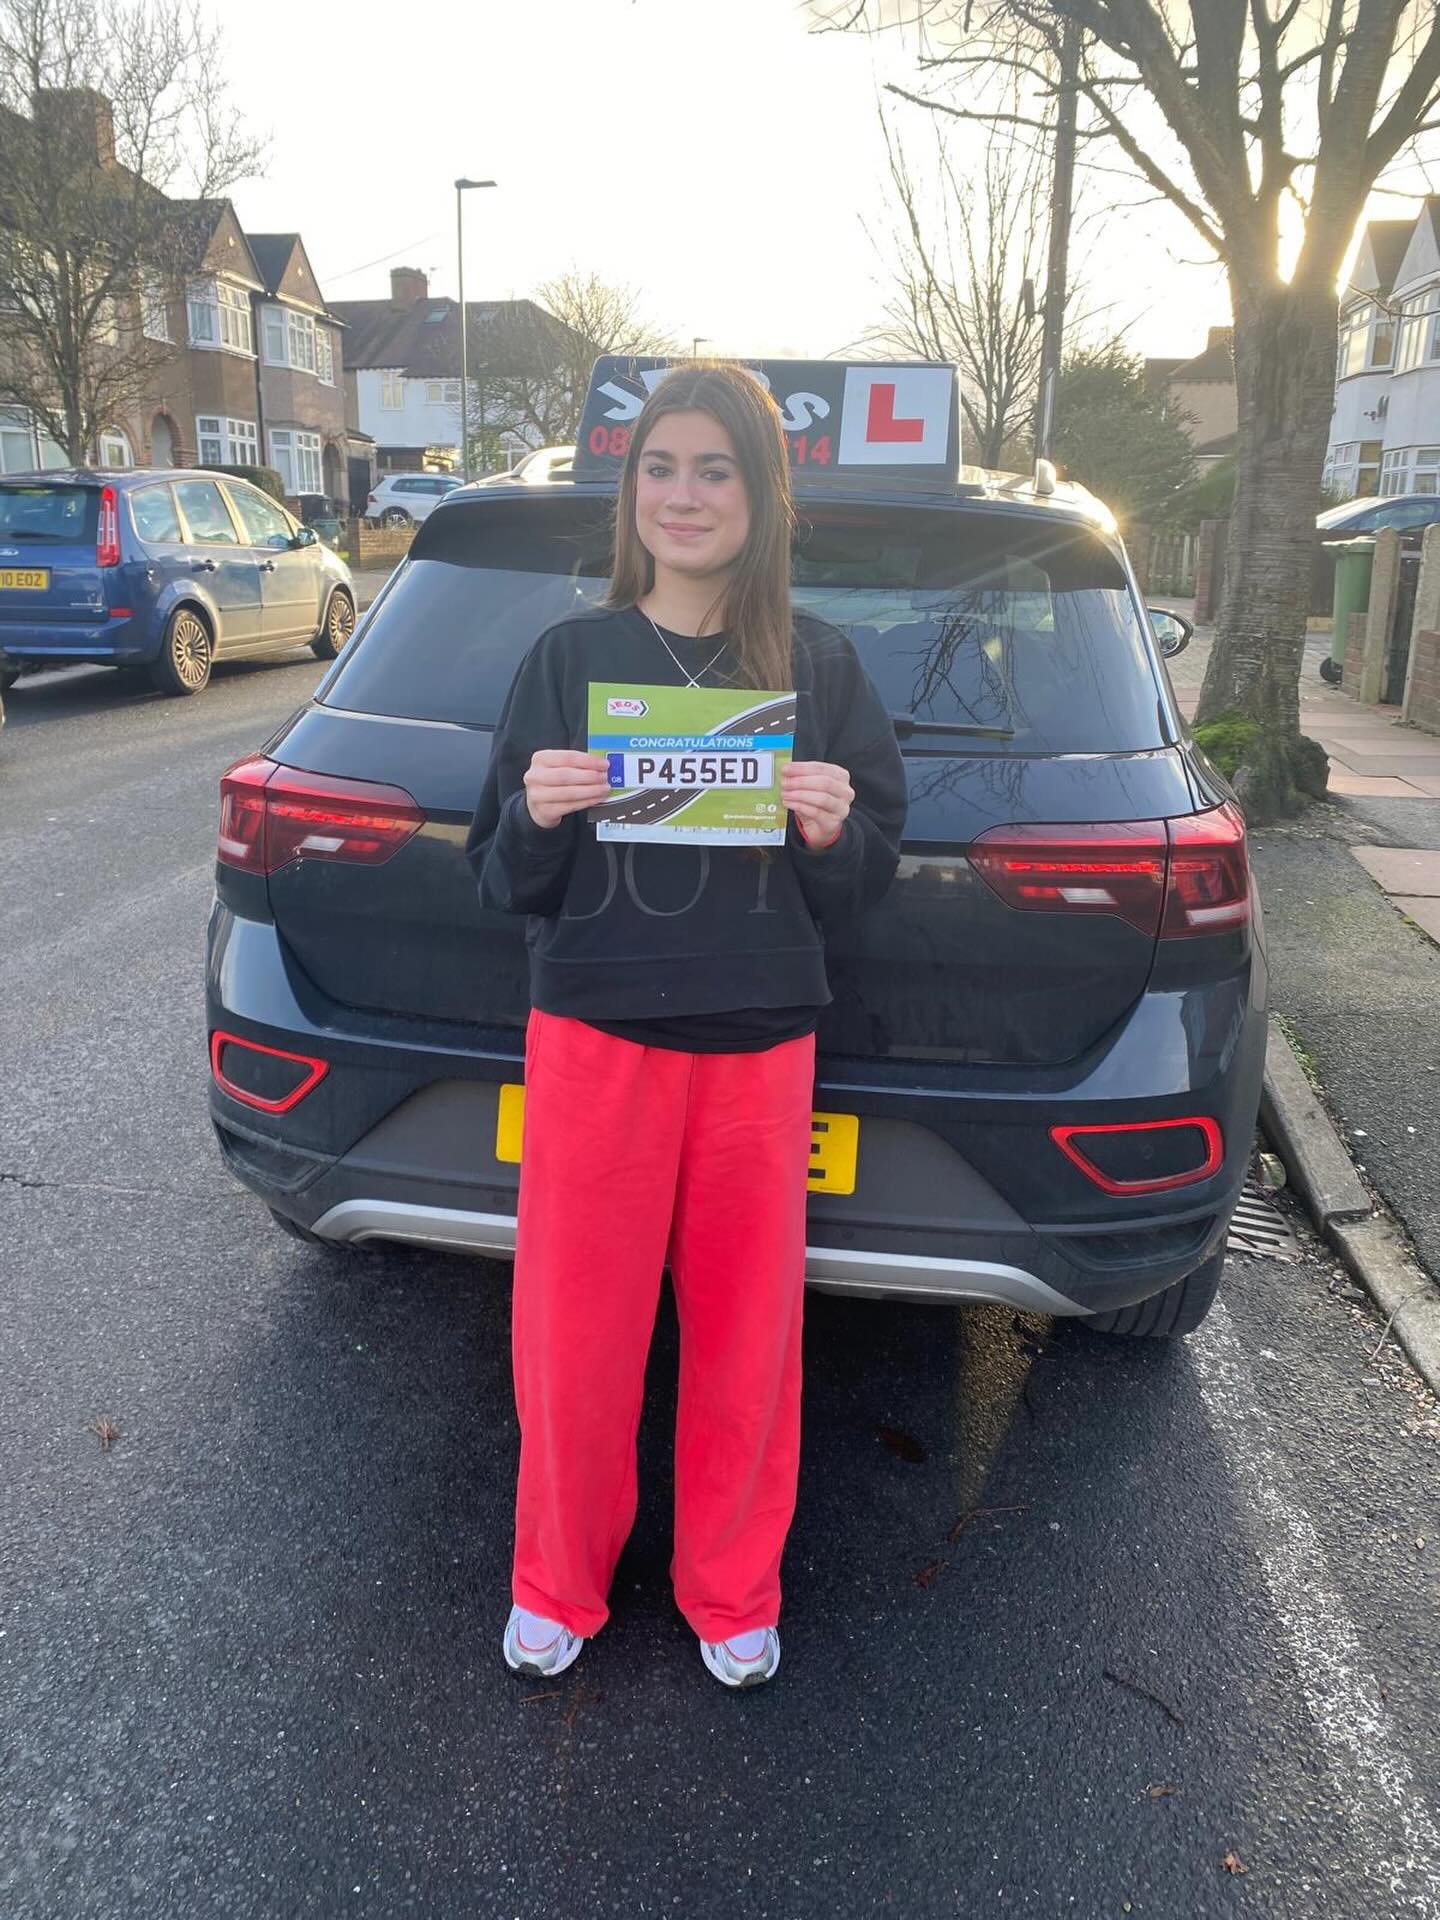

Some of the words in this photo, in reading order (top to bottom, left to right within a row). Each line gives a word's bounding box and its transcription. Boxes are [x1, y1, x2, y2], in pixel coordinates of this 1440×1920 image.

[596, 368, 830, 431] JS
[866, 383, 925, 443] L
[629, 736, 755, 749] CONGRATULATIONS
